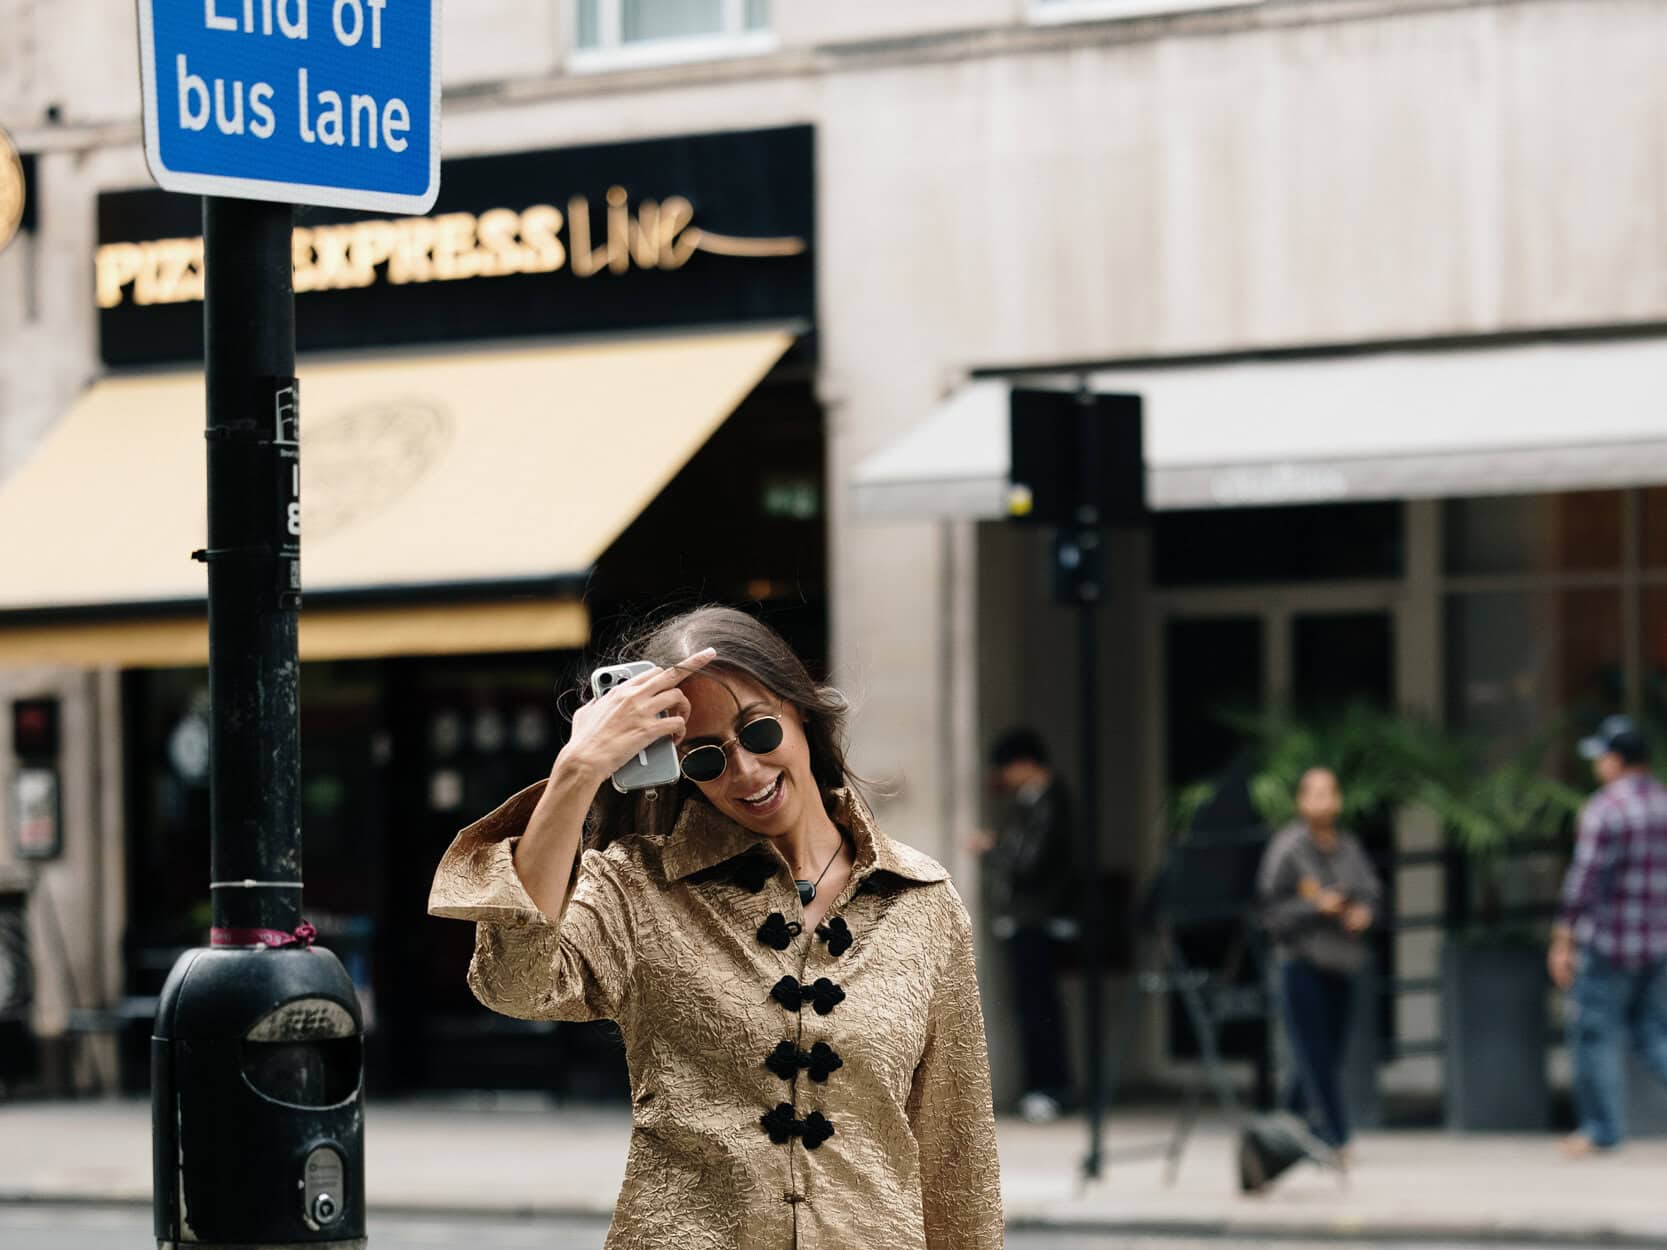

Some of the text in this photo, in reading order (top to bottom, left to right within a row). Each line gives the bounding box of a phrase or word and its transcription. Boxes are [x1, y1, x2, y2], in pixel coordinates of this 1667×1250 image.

[332, 0, 386, 49] of
[176, 53, 411, 153] bus lane
[567, 184, 804, 278] Live
